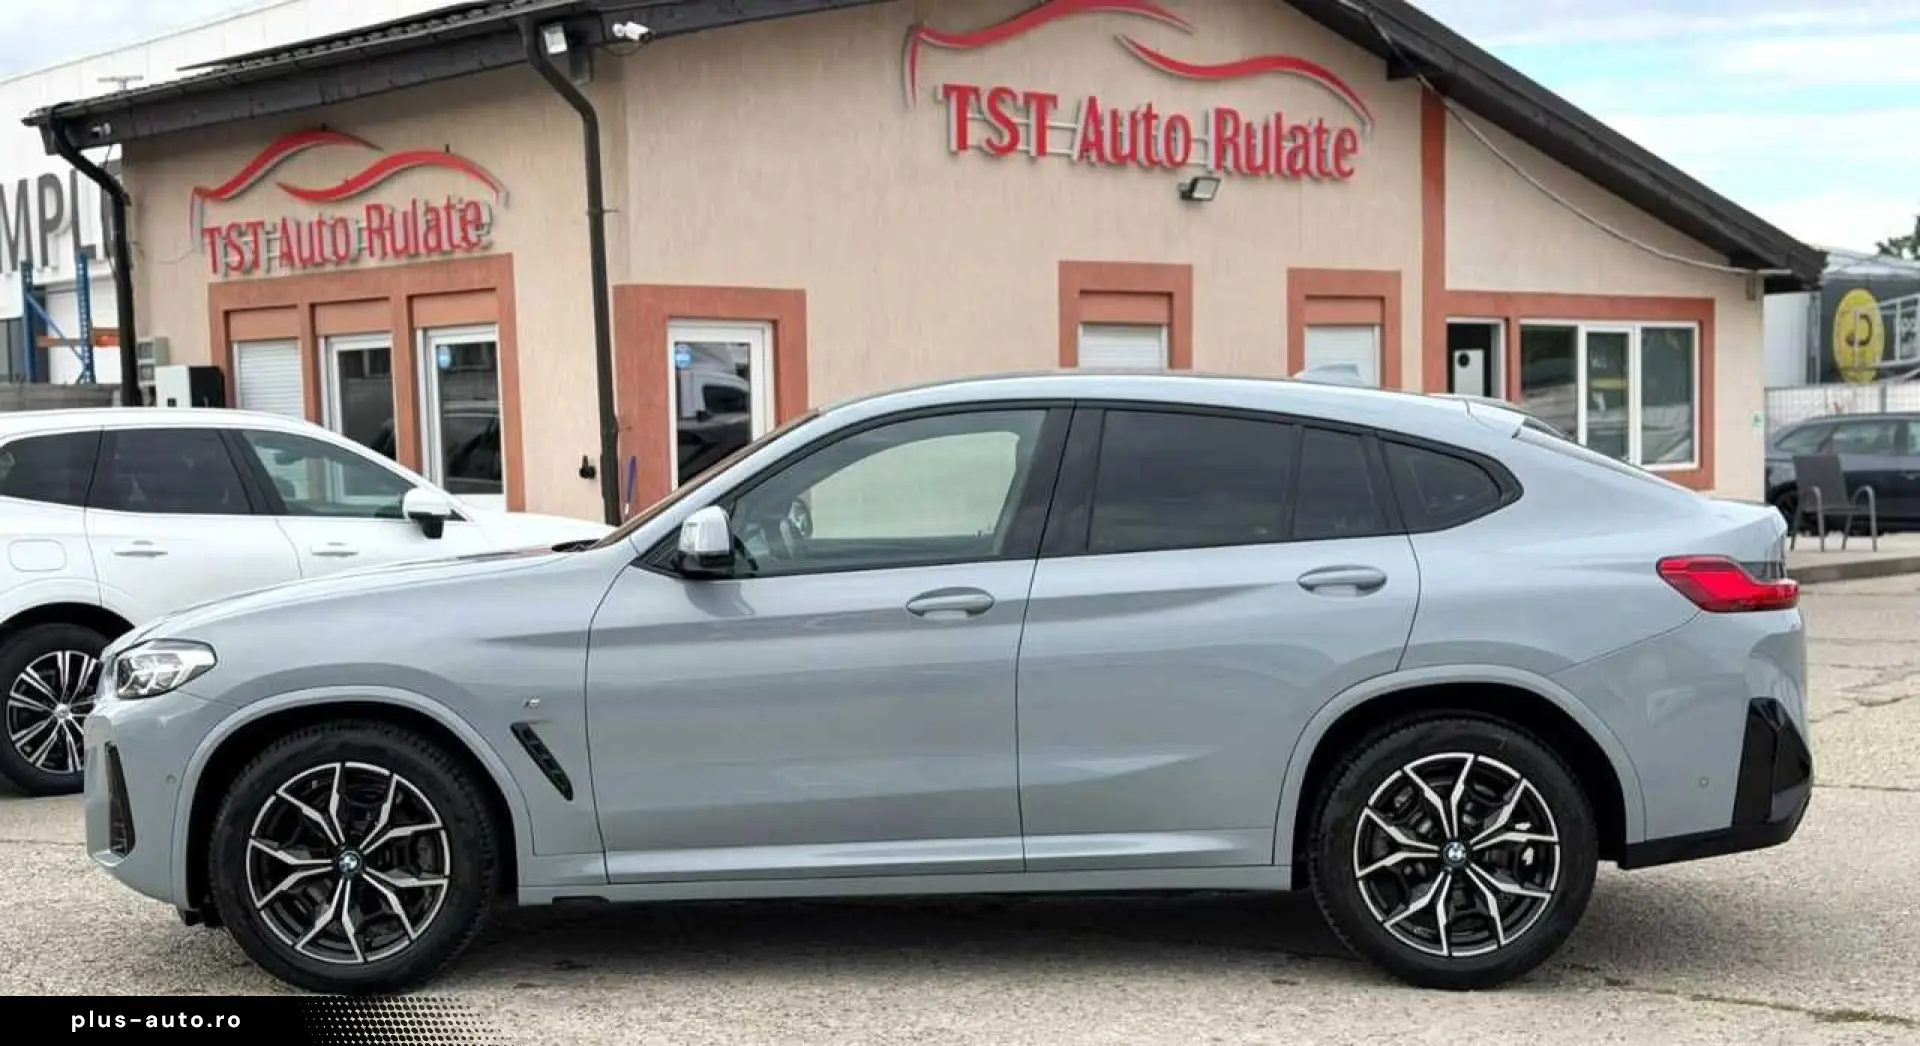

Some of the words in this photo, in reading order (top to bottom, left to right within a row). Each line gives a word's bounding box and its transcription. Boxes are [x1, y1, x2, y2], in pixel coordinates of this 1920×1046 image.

[942, 83, 1058, 156] TST
[1077, 95, 1192, 168] Auto
[1213, 107, 1358, 178] Rulate
[203, 220, 265, 275] TST
[279, 215, 350, 269] Auto
[364, 195, 482, 259] Rulate
